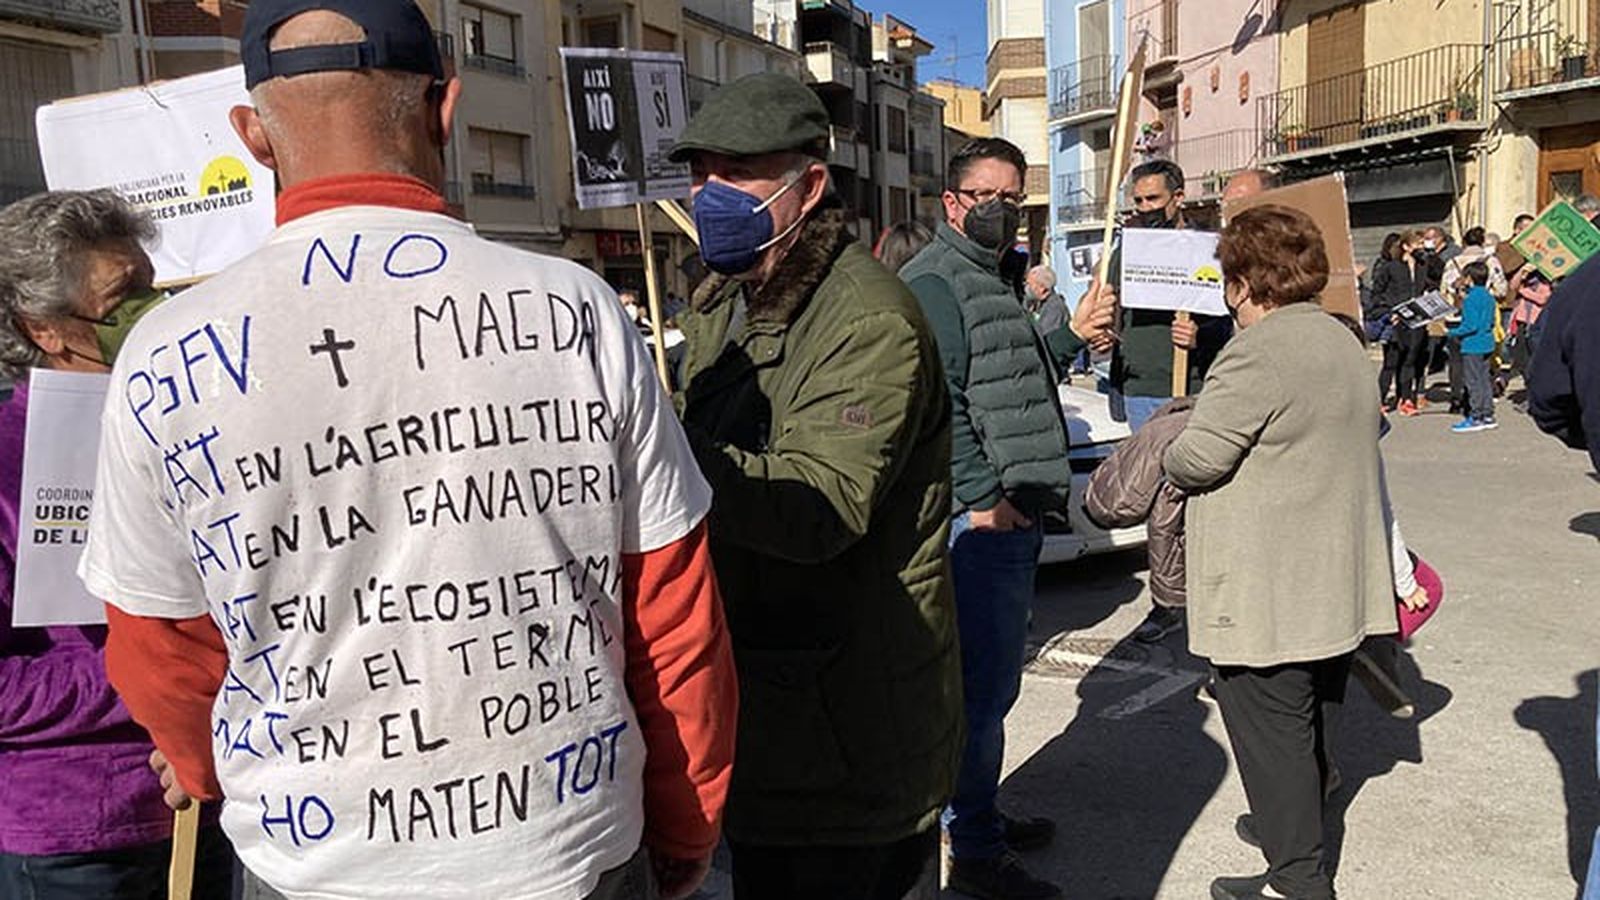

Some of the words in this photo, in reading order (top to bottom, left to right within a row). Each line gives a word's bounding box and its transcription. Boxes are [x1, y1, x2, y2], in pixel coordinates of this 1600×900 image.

[584, 92, 615, 131] NO
[178, 190, 254, 216] RENOVABLES
[302, 233, 448, 286] NO
[126, 315, 250, 447] PSFV
[414, 289, 597, 371] MAGDA
[35, 505, 89, 521] UBIC
[319, 505, 376, 548] LA
[403, 463, 621, 527] GANADERI
[33, 529, 63, 544] DE
[363, 649, 421, 690] EL
[380, 709, 449, 759] EL
[481, 666, 602, 738] POBLE
[260, 794, 335, 846] HO
[367, 765, 530, 843] MATEN
[545, 721, 628, 803] TOT
